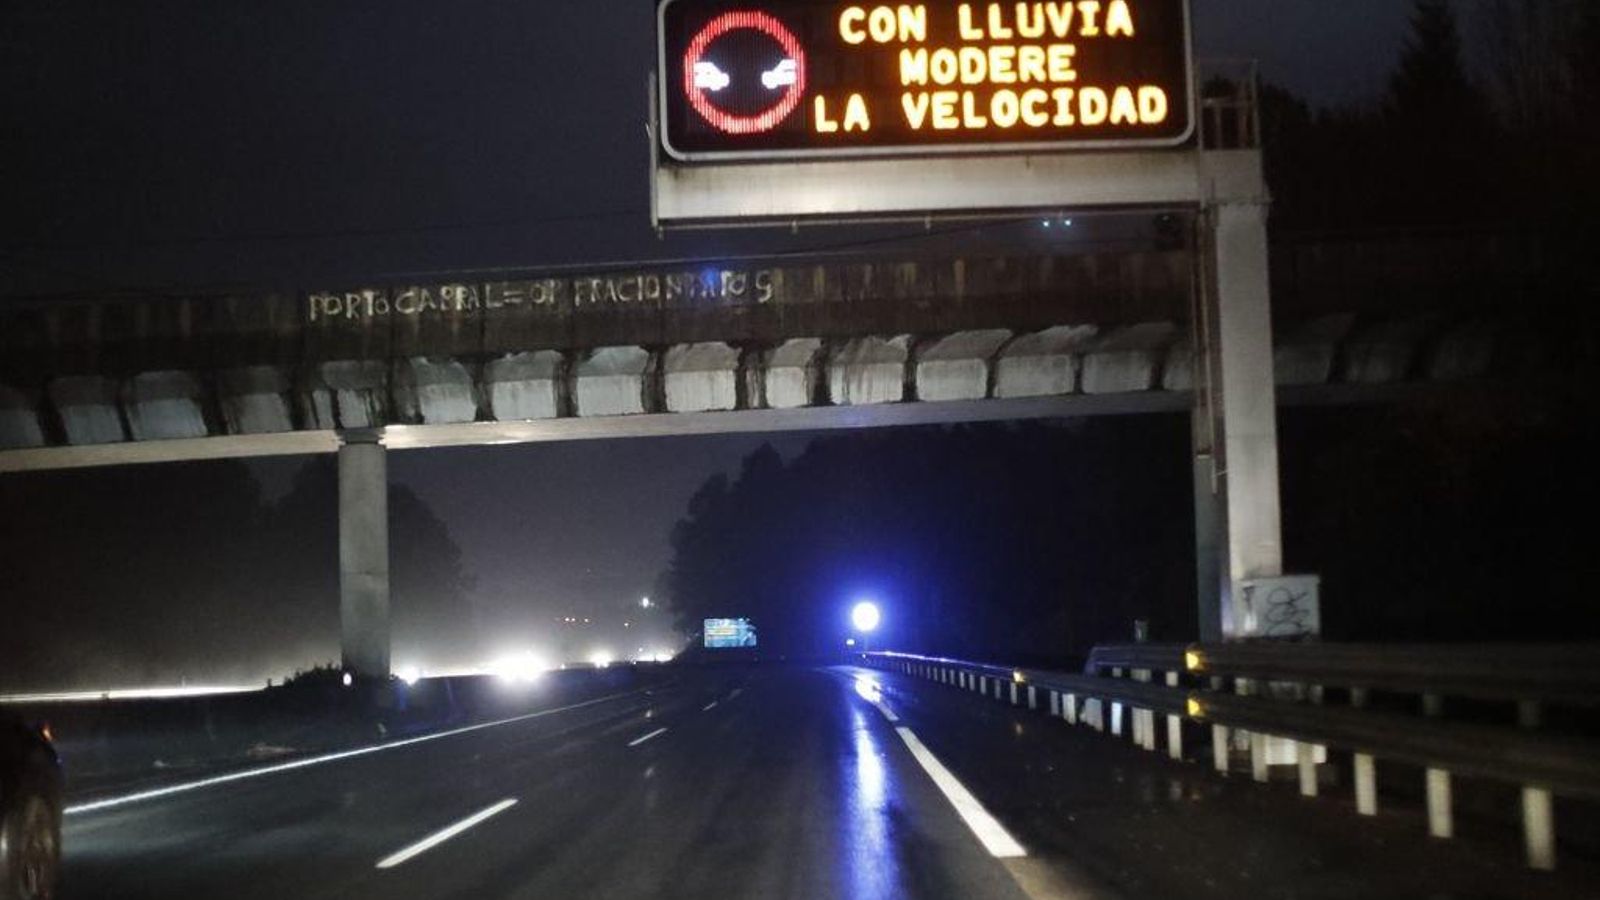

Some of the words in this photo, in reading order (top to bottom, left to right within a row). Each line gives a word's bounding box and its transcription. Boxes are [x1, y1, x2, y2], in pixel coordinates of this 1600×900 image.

[839, 4, 927, 44] CON
[958, 0, 1135, 41] LLUVIA
[900, 44, 1077, 86] MODERE
[814, 93, 870, 134] LA
[901, 85, 1168, 130] VELOCIDAD
[308, 290, 391, 322] PORTO
